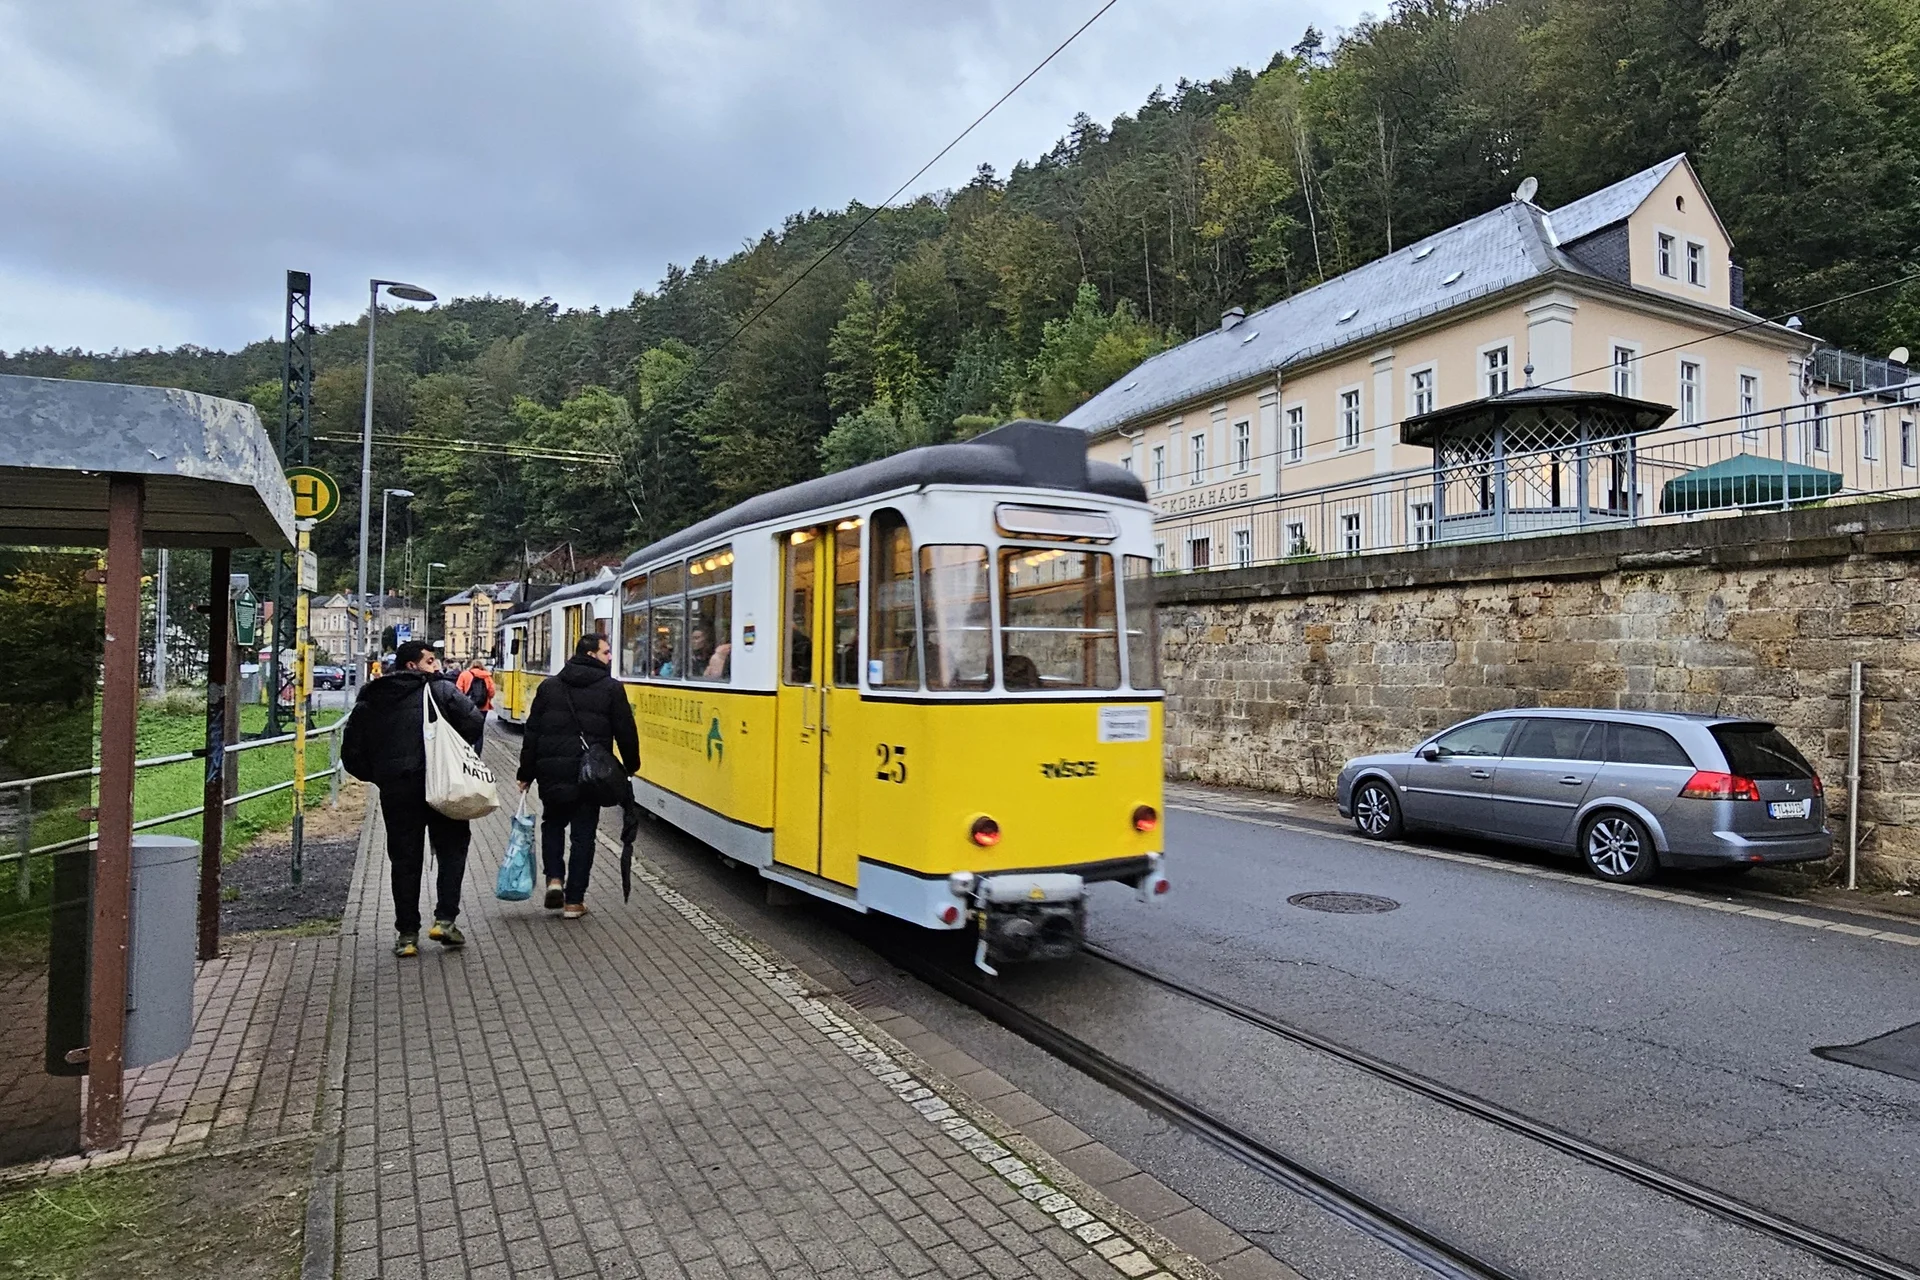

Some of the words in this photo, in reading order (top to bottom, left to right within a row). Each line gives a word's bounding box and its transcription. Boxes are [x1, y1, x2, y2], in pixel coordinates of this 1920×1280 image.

[290, 479, 318, 511] H
[463, 762, 497, 784] NATU
[876, 743, 907, 784] 25
